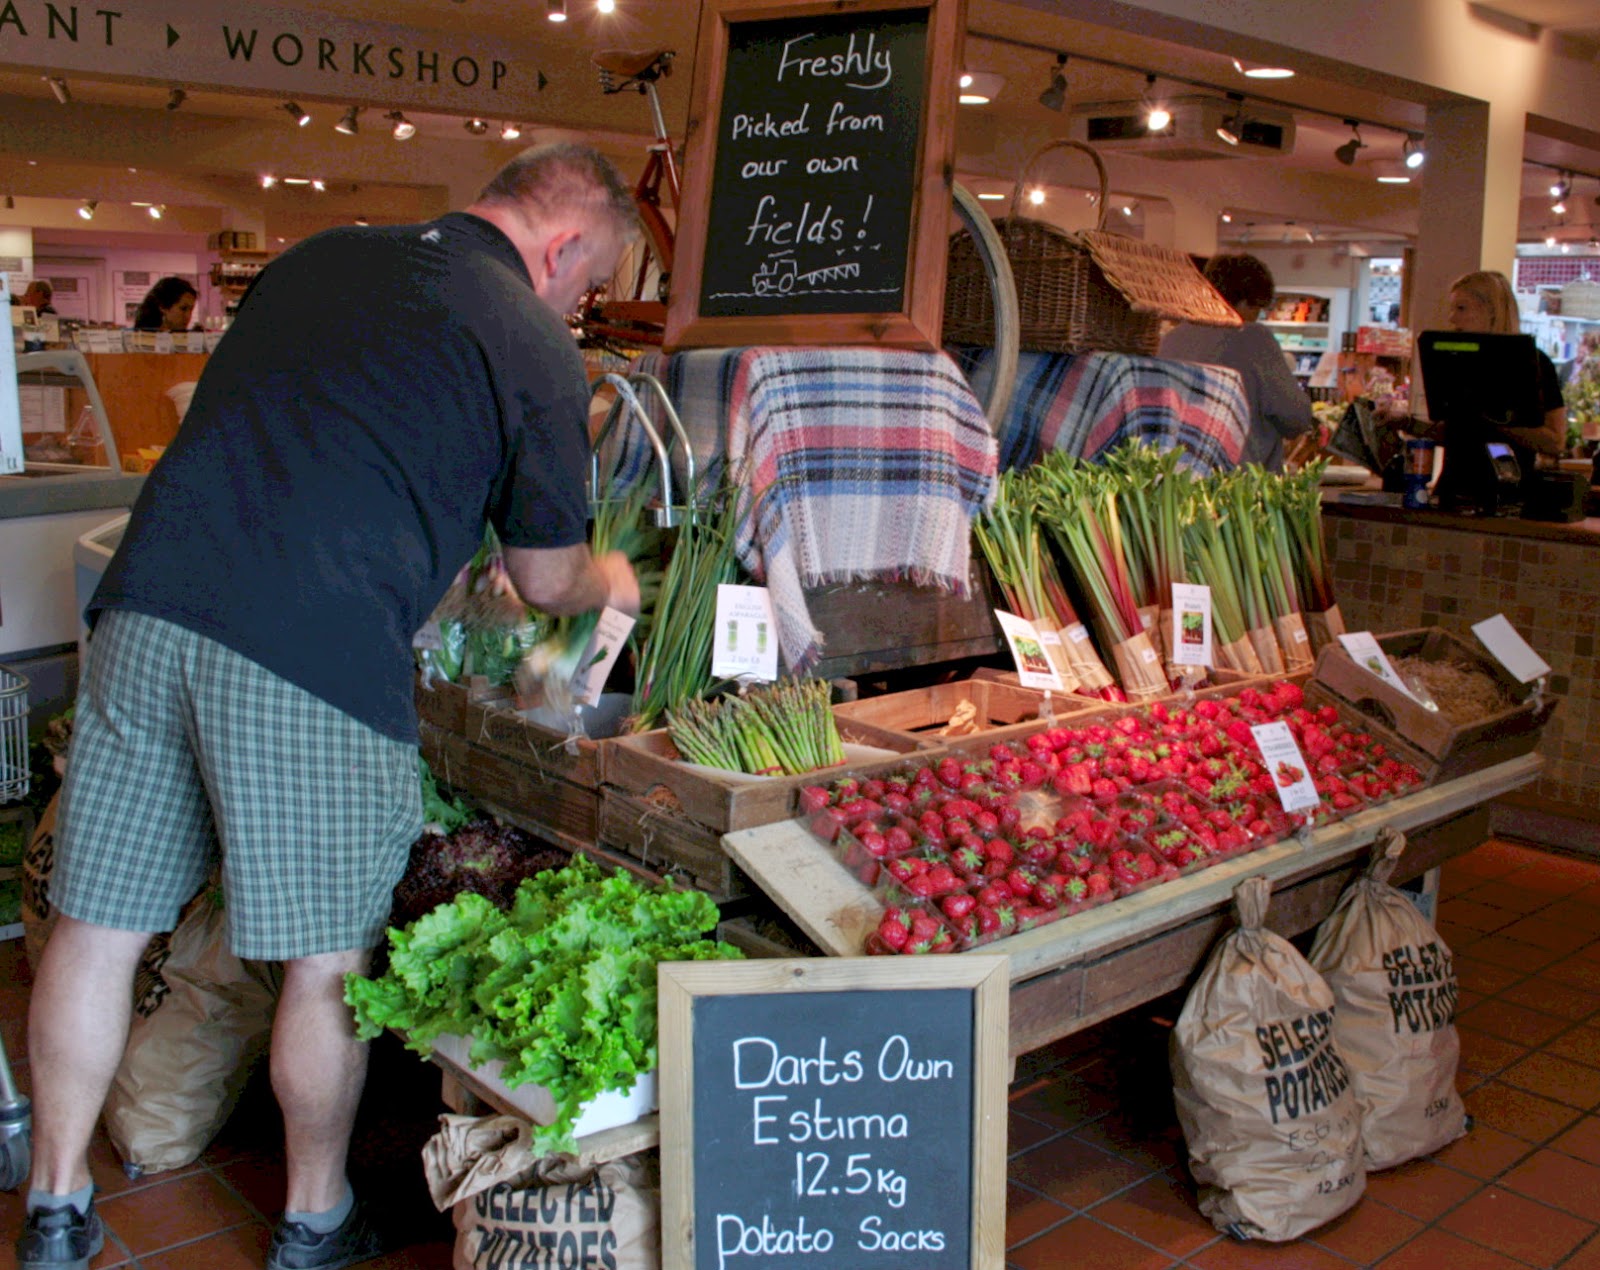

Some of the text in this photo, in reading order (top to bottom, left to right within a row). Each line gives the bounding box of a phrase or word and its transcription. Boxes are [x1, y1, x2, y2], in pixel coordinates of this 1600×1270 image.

[222, 25, 507, 90] WORKSHOP
[777, 32, 892, 90] Freshly
[732, 101, 884, 140] Picked from
[741, 156, 859, 179] our own
[732, 1034, 954, 1090] Darts Own
[753, 1094, 909, 1146] Estima
[857, 1215, 946, 1252] Sacks
